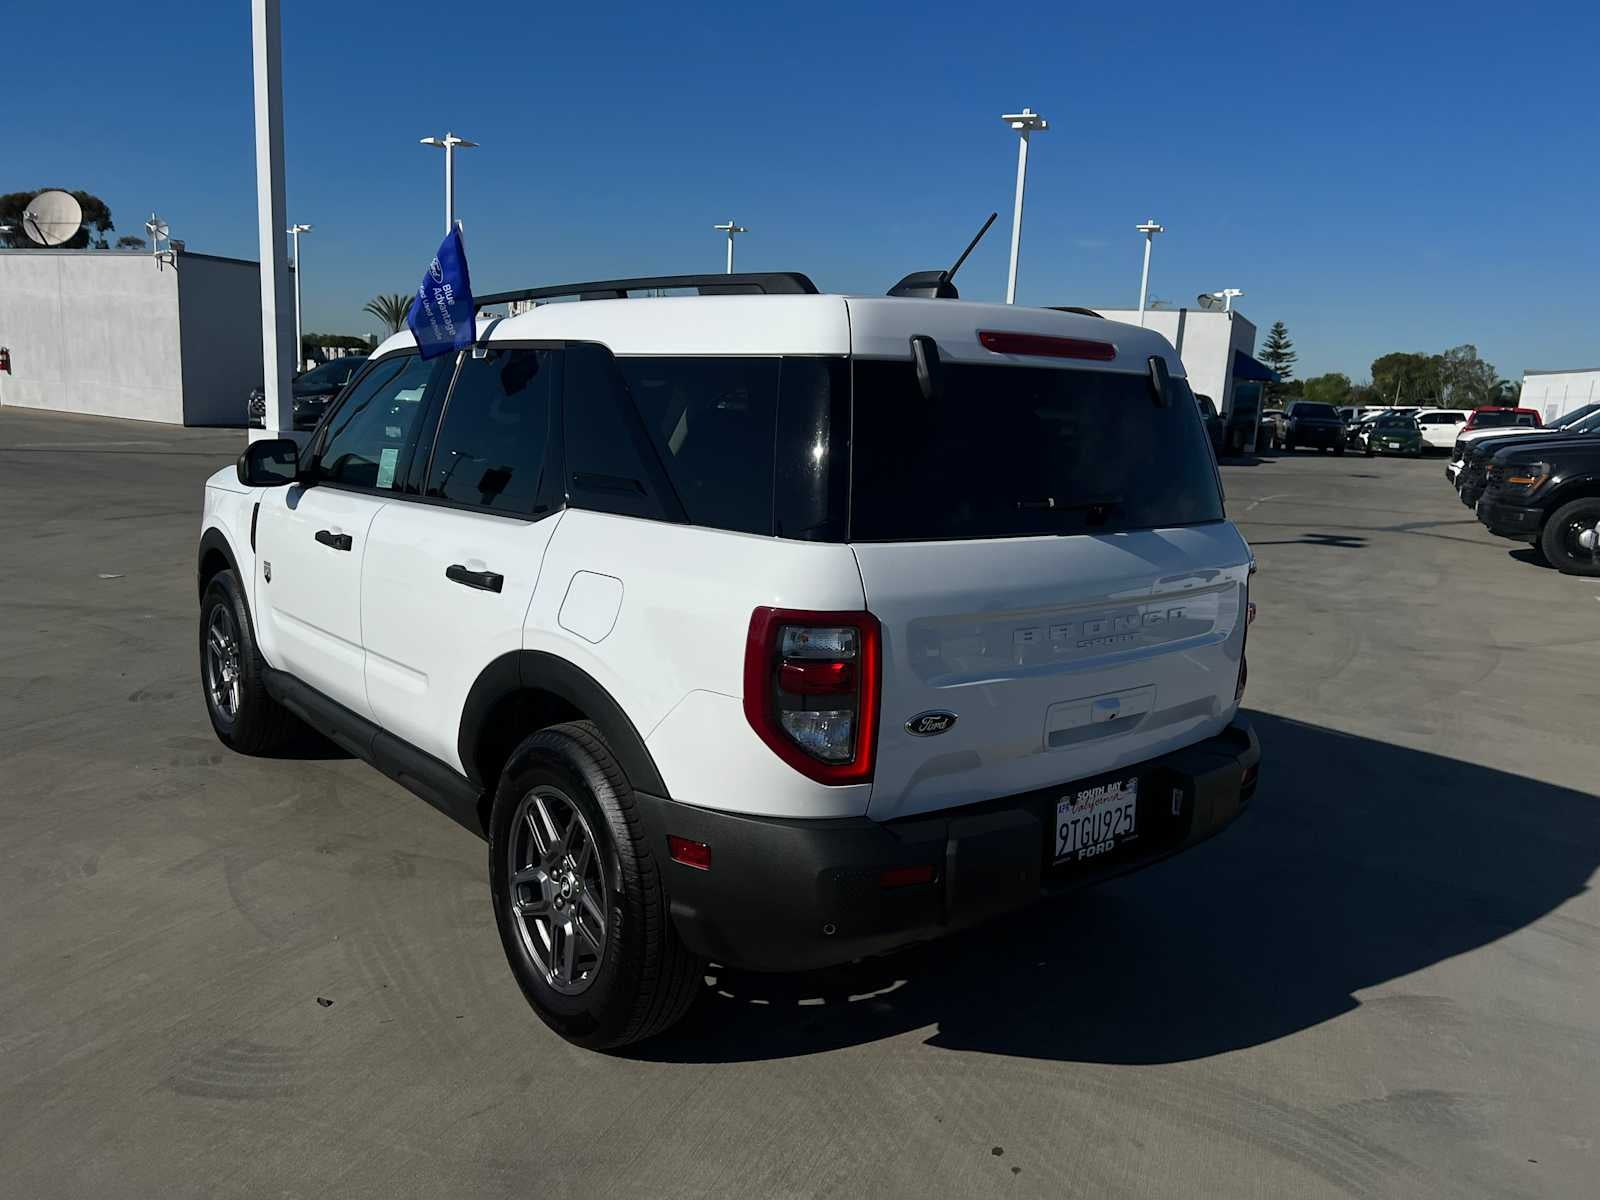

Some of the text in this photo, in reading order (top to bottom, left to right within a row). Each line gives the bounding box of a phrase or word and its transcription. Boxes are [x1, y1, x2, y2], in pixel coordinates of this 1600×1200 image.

[442, 283, 456, 306] Blue
[422, 299, 434, 317] Used
[432, 287, 457, 336] Advantage
[918, 715, 949, 732] Ford
[1077, 780, 1122, 801] SOUTH BAY
[1059, 803, 1134, 857] 9TGU925
[1077, 840, 1115, 861] FORD
